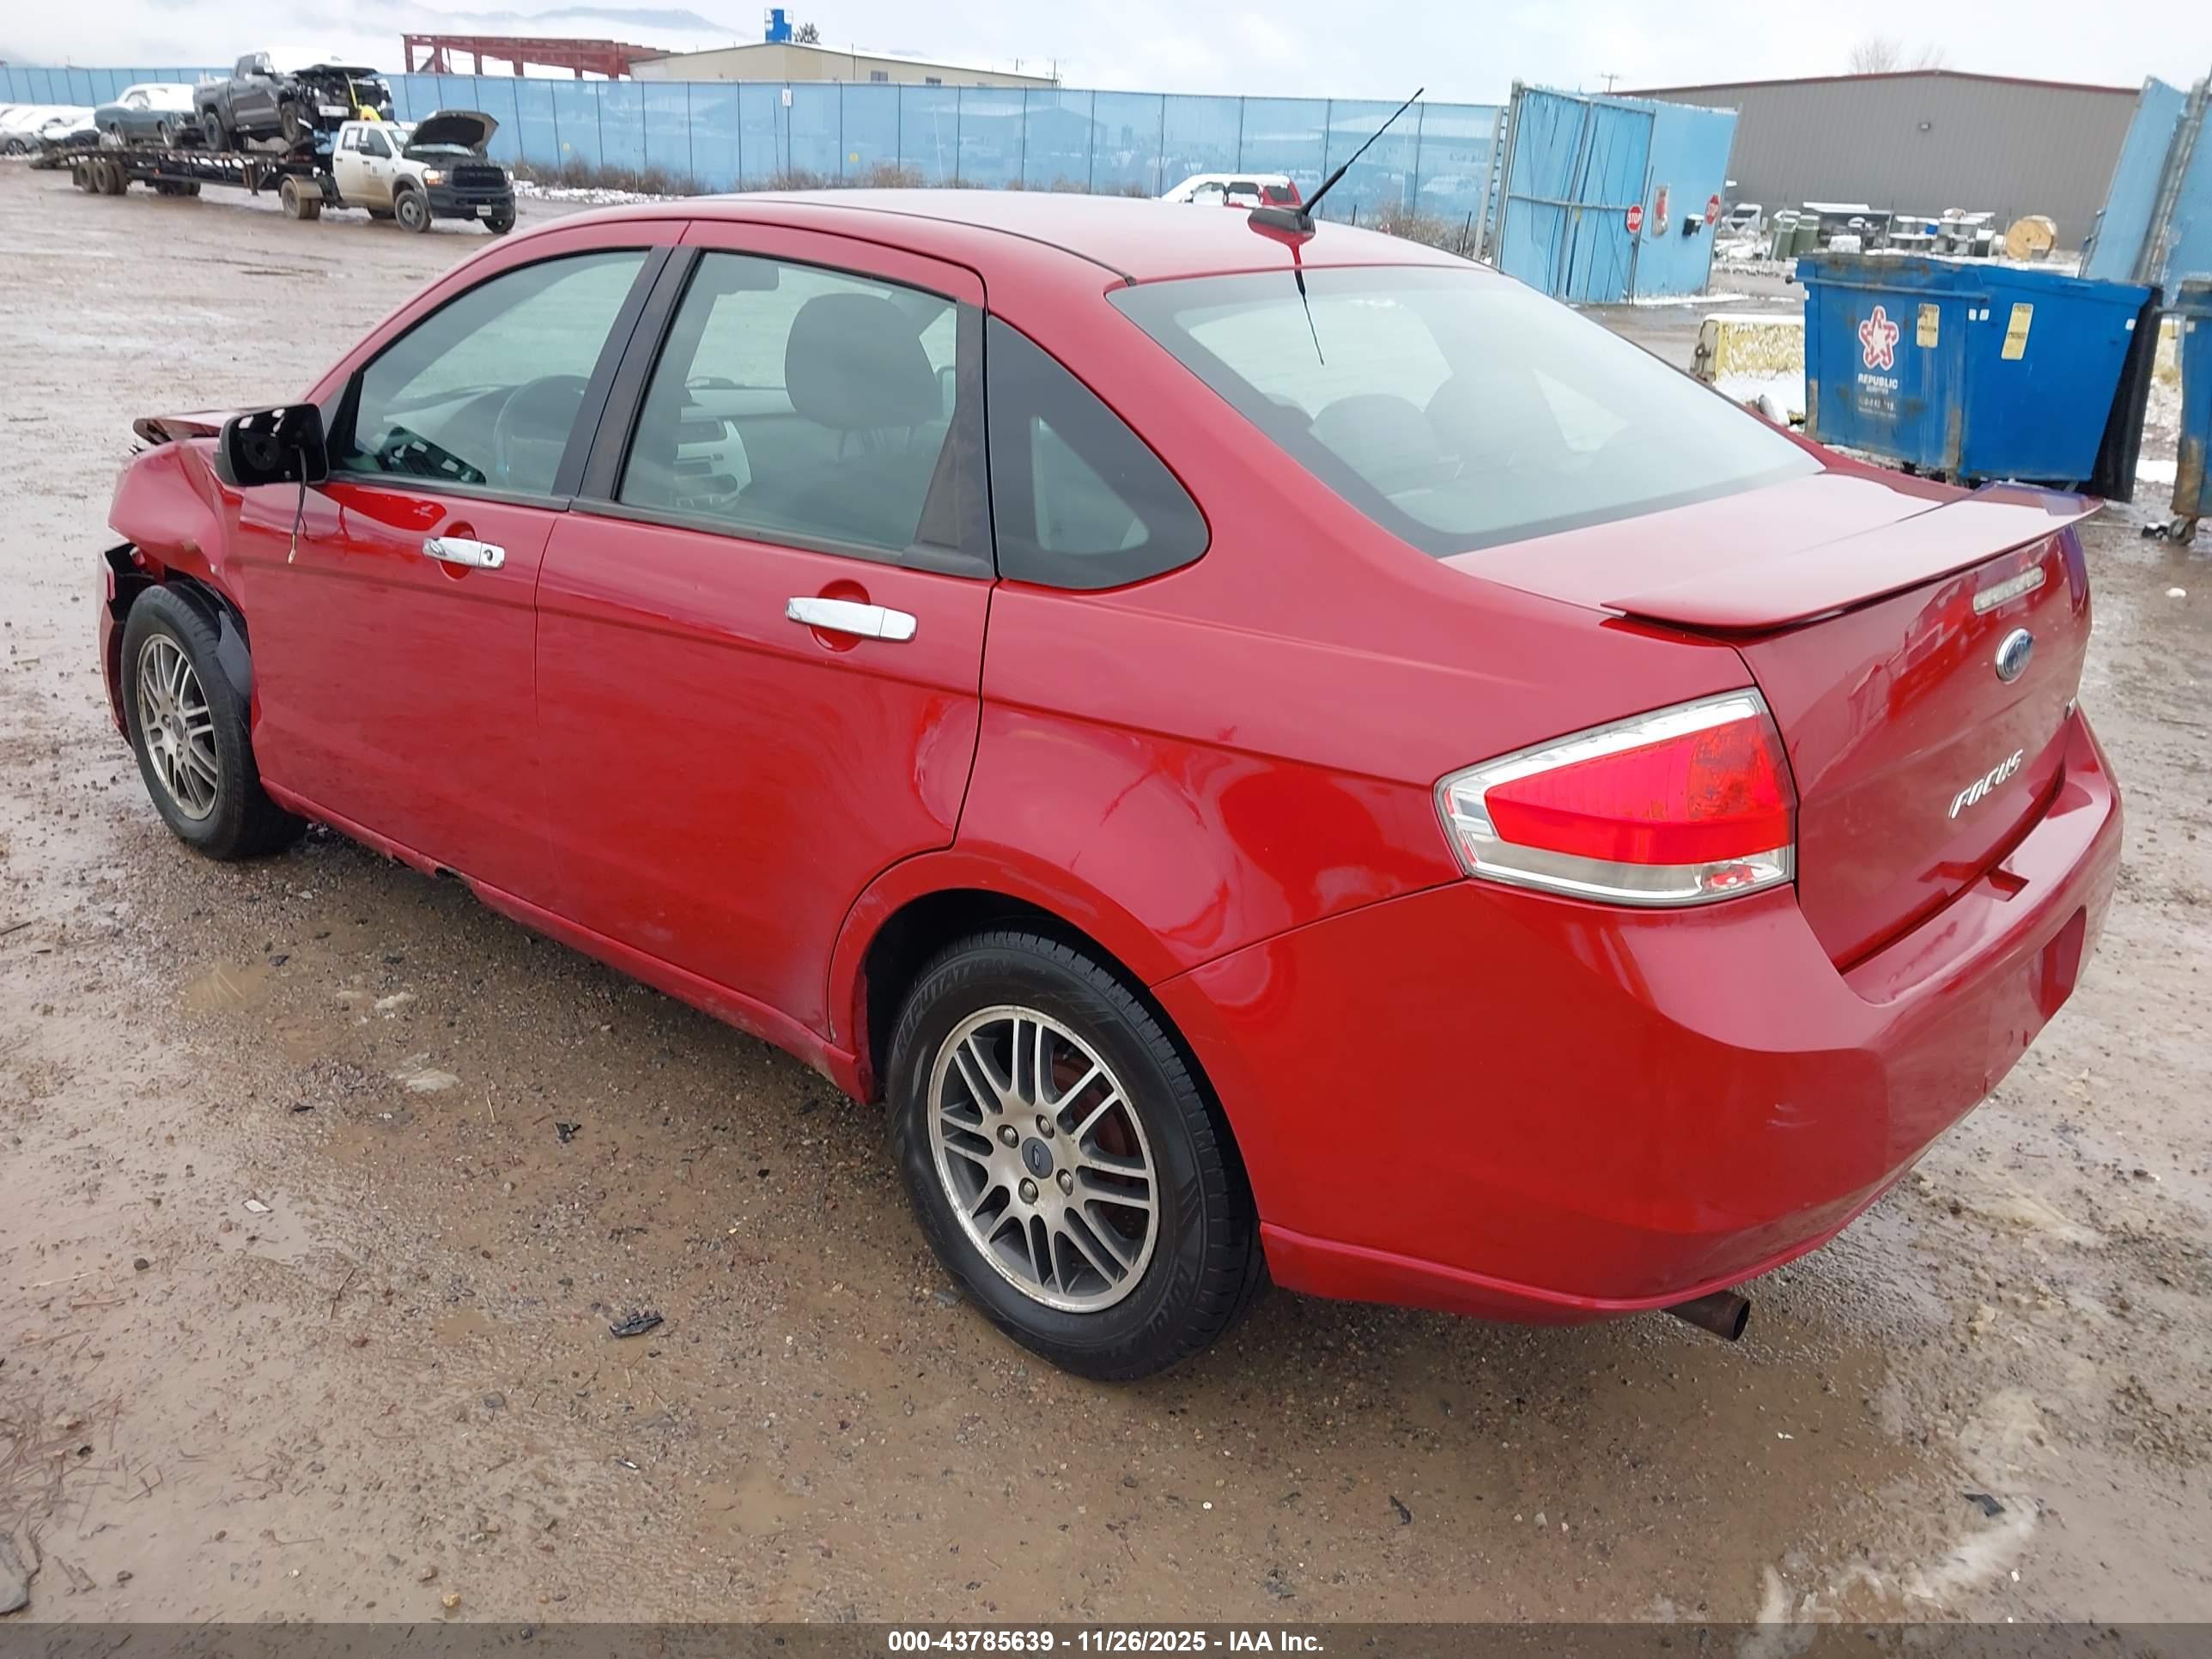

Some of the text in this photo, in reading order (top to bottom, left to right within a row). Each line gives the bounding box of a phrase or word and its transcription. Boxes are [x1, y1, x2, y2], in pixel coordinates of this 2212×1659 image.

[1628, 212, 1641, 224] STOP
[1857, 373, 1899, 390] REPUBLIC
[1948, 748, 2024, 819] FOCUS
